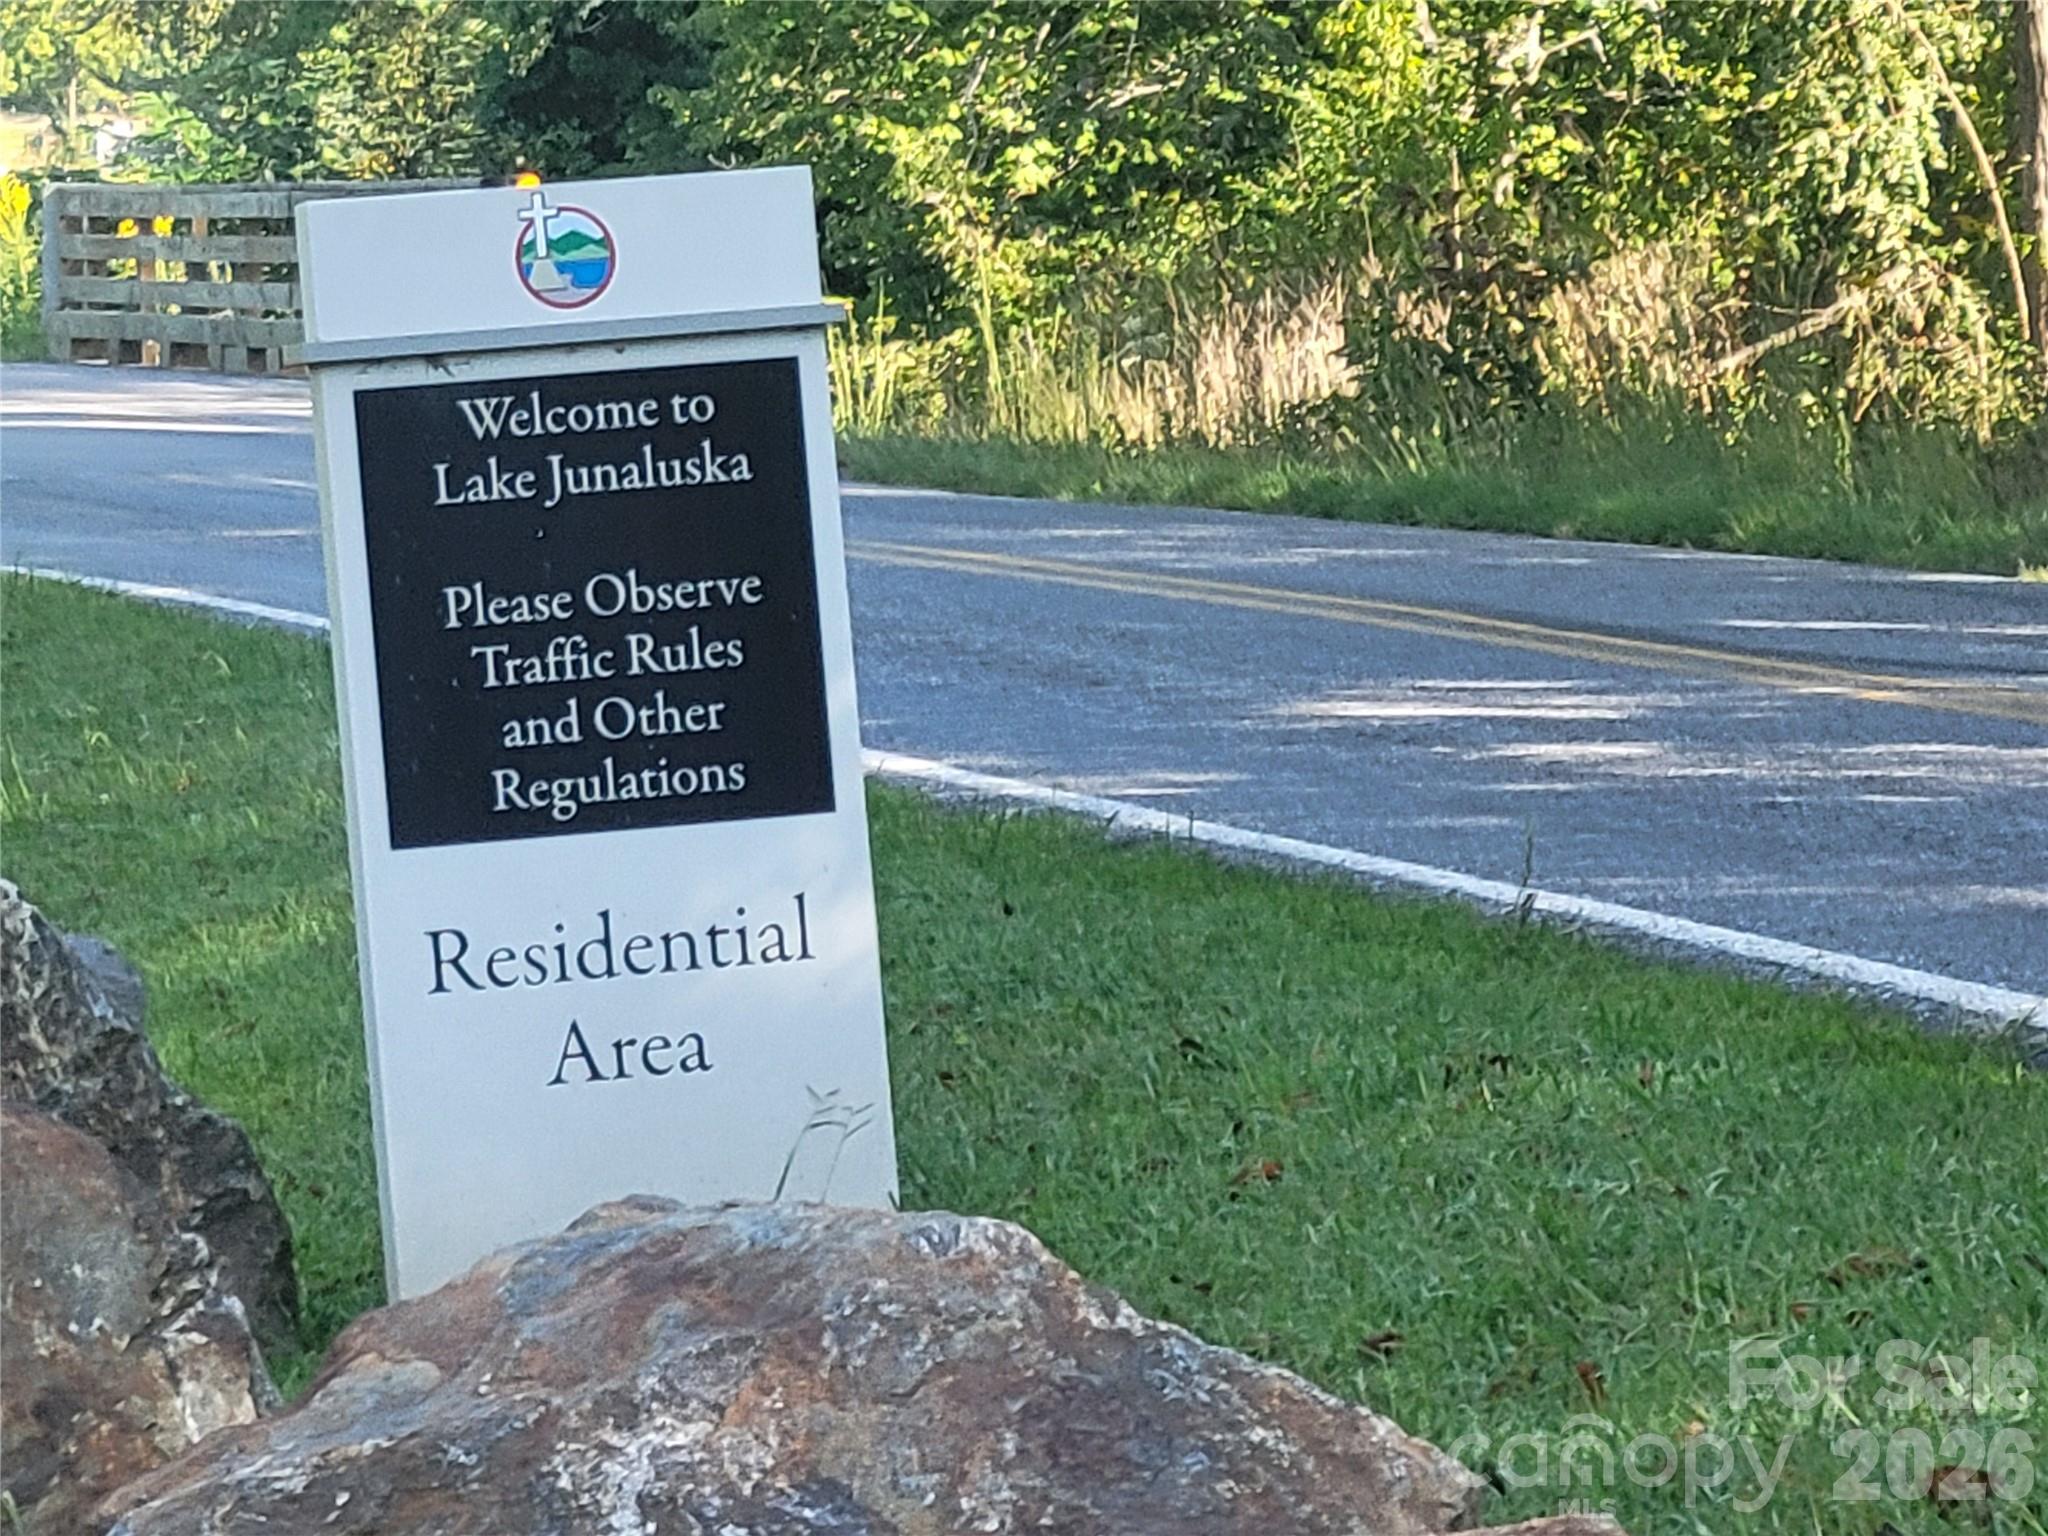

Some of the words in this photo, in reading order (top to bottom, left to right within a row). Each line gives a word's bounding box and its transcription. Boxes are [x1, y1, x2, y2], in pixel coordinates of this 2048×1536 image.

[457, 391, 659, 440] Welcome
[671, 393, 715, 424] to
[433, 456, 536, 506] Lake
[544, 439, 753, 508] Junaluska
[443, 581, 574, 630] Please
[585, 569, 763, 617] Observe
[471, 635, 614, 688] Traffic
[626, 627, 743, 675] Rules
[502, 698, 582, 748] and
[594, 690, 725, 740] Other
[491, 757, 746, 821] Regulations
[424, 891, 816, 995] Residential
[546, 1019, 713, 1086] Area
